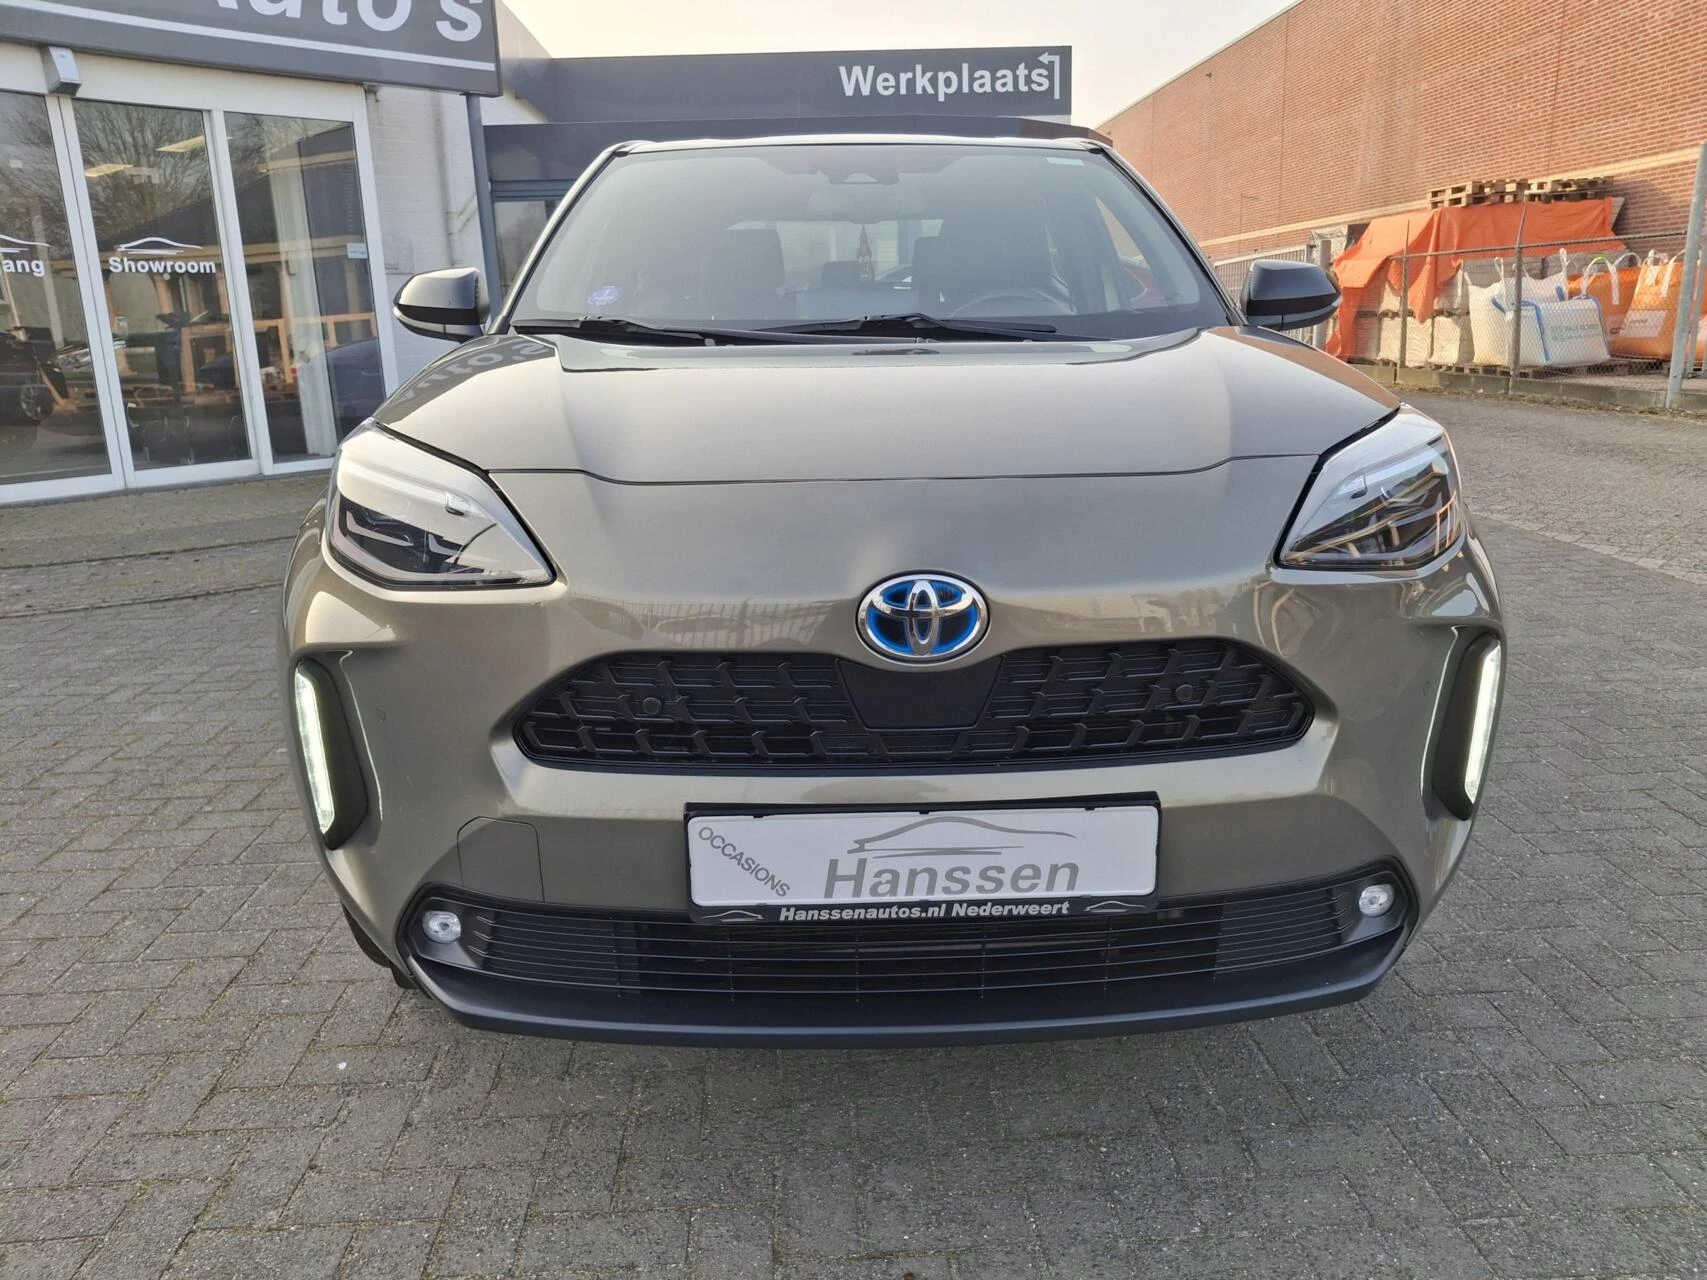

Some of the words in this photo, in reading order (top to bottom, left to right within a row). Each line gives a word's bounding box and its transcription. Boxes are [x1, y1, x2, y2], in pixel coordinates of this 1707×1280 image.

[838, 62, 1050, 102] Werkplaats
[108, 256, 216, 274] Showroom
[698, 826, 791, 897] OCCASIONS
[823, 857, 1080, 899] Hanssen
[779, 903, 946, 921] Hanssenautos.nl
[951, 901, 1070, 917] Nederweert
